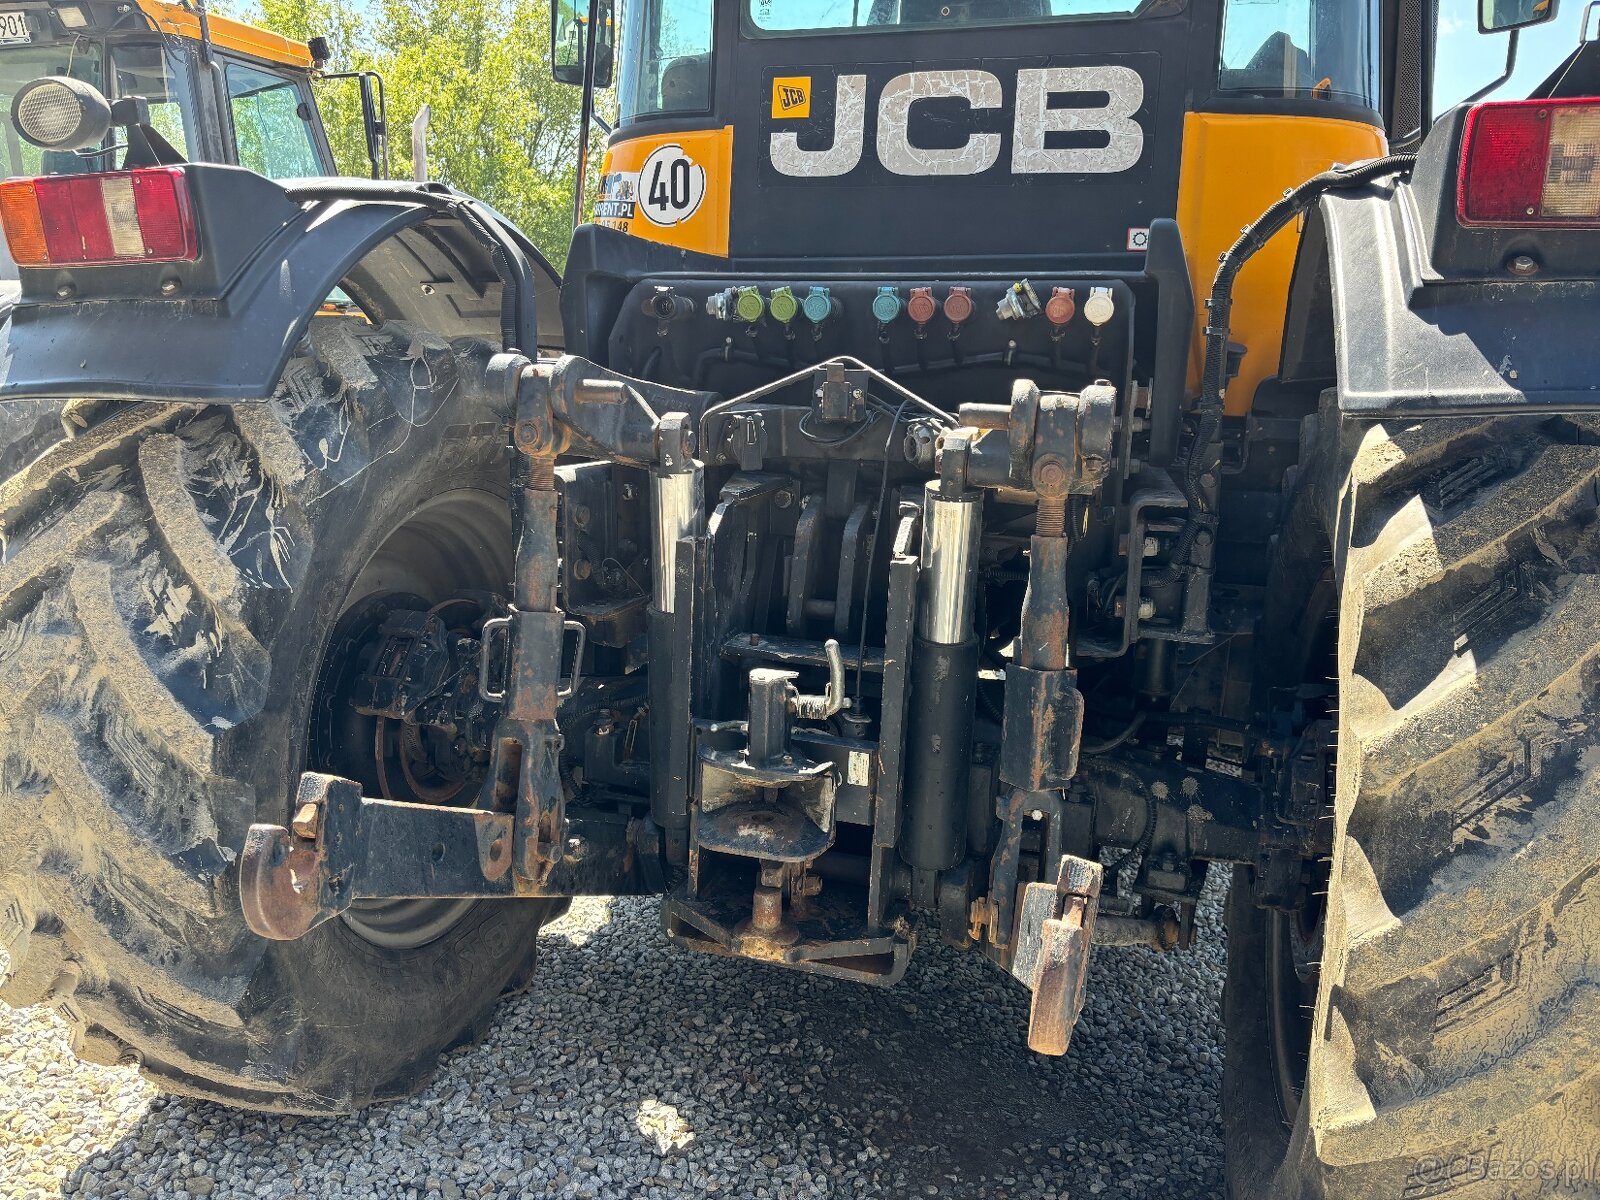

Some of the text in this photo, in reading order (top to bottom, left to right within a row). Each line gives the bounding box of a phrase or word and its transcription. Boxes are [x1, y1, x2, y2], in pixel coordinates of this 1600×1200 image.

[770, 65, 1144, 177] JCB
[782, 88, 804, 107] JCB
[648, 158, 691, 211] 40
